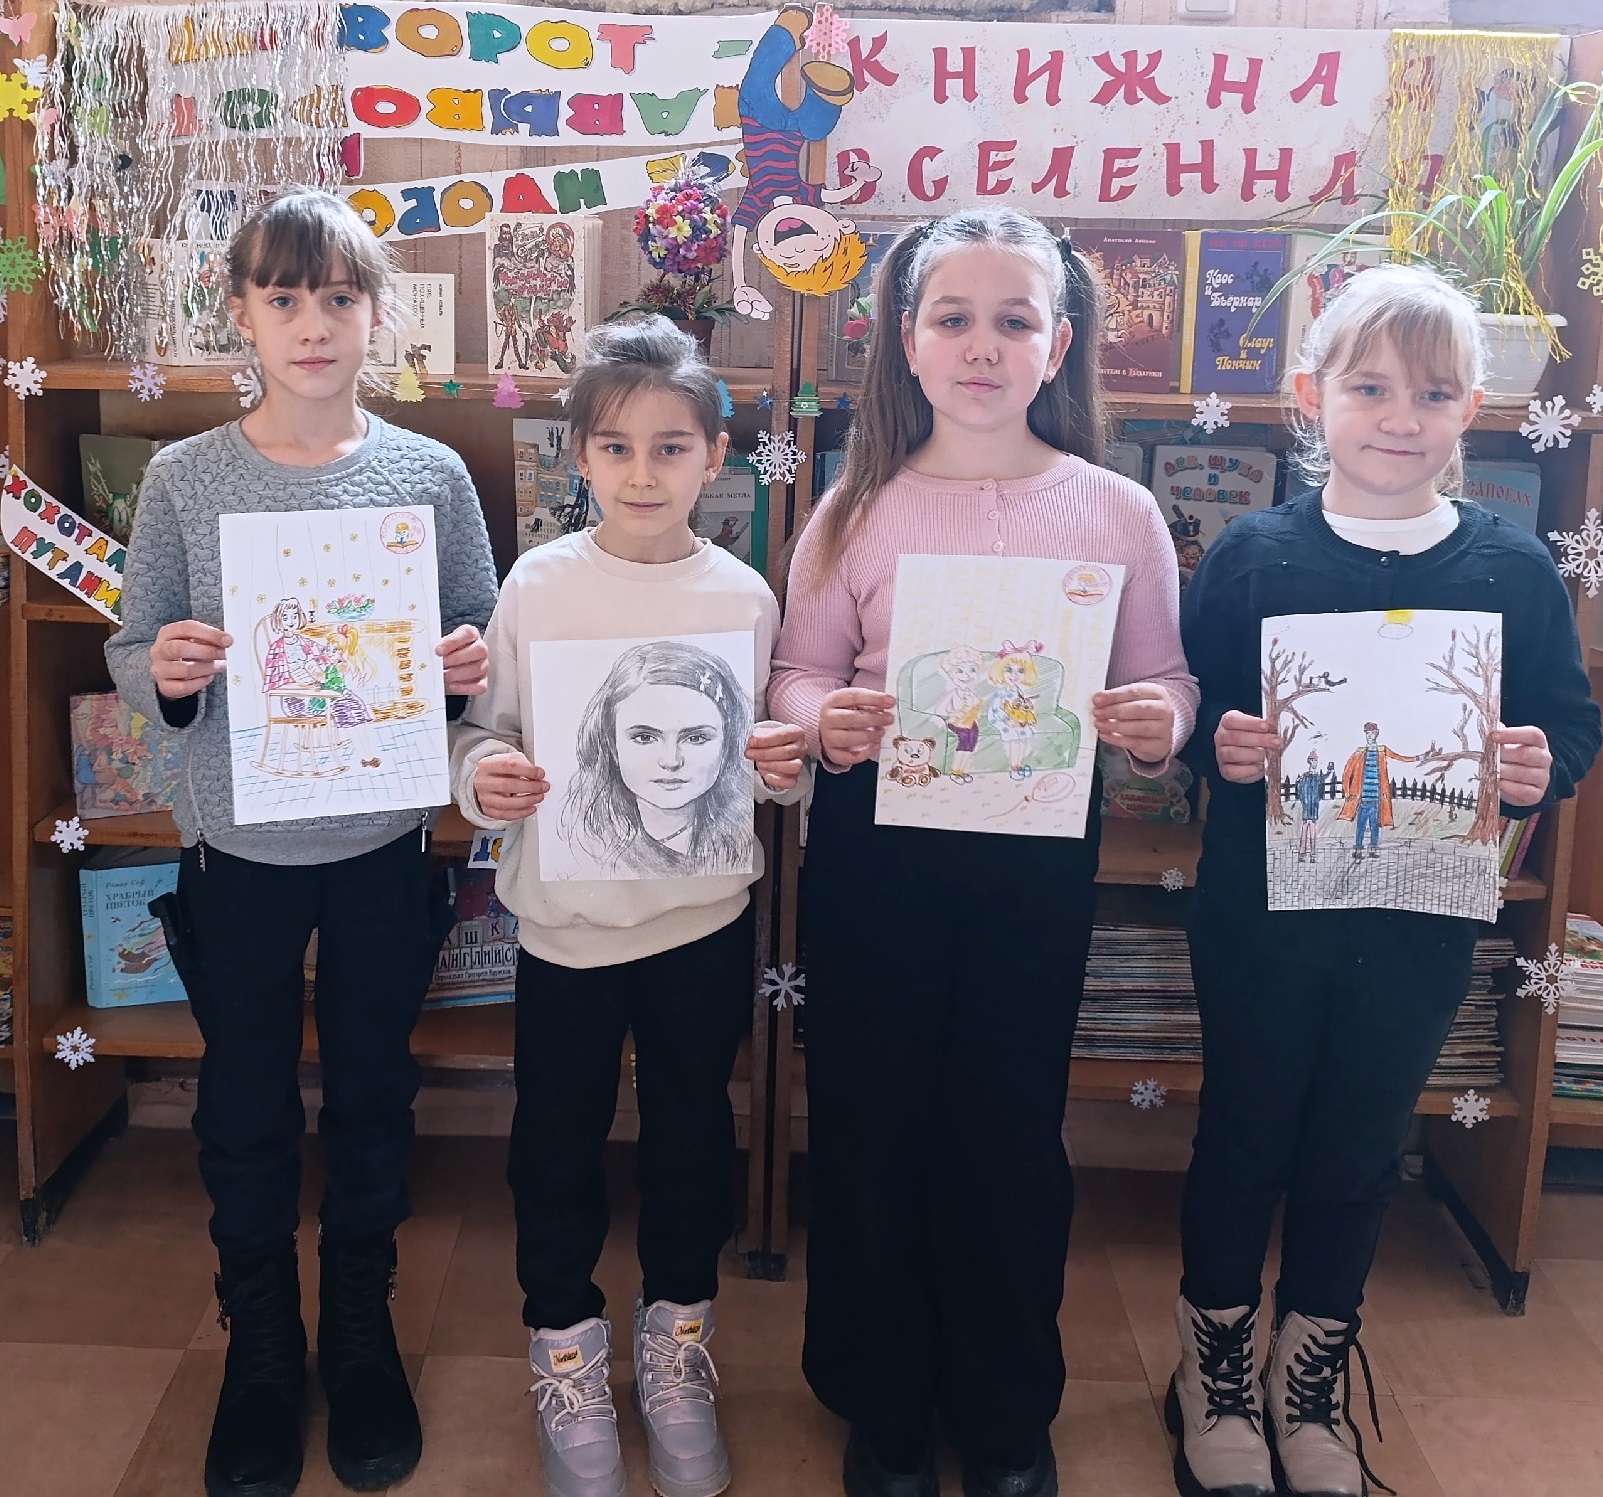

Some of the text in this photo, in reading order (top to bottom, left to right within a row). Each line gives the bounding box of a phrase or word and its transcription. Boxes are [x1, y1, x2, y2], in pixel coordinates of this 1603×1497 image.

[1205, 269, 1234, 288] Каос
[1170, 485, 1251, 505] ЧЕЛОВЕК
[1467, 480, 1533, 507] САПОГАХ
[105, 889, 154, 901] ХРАБРЫЙ
[105, 898, 146, 910] ЦВЕТОК
